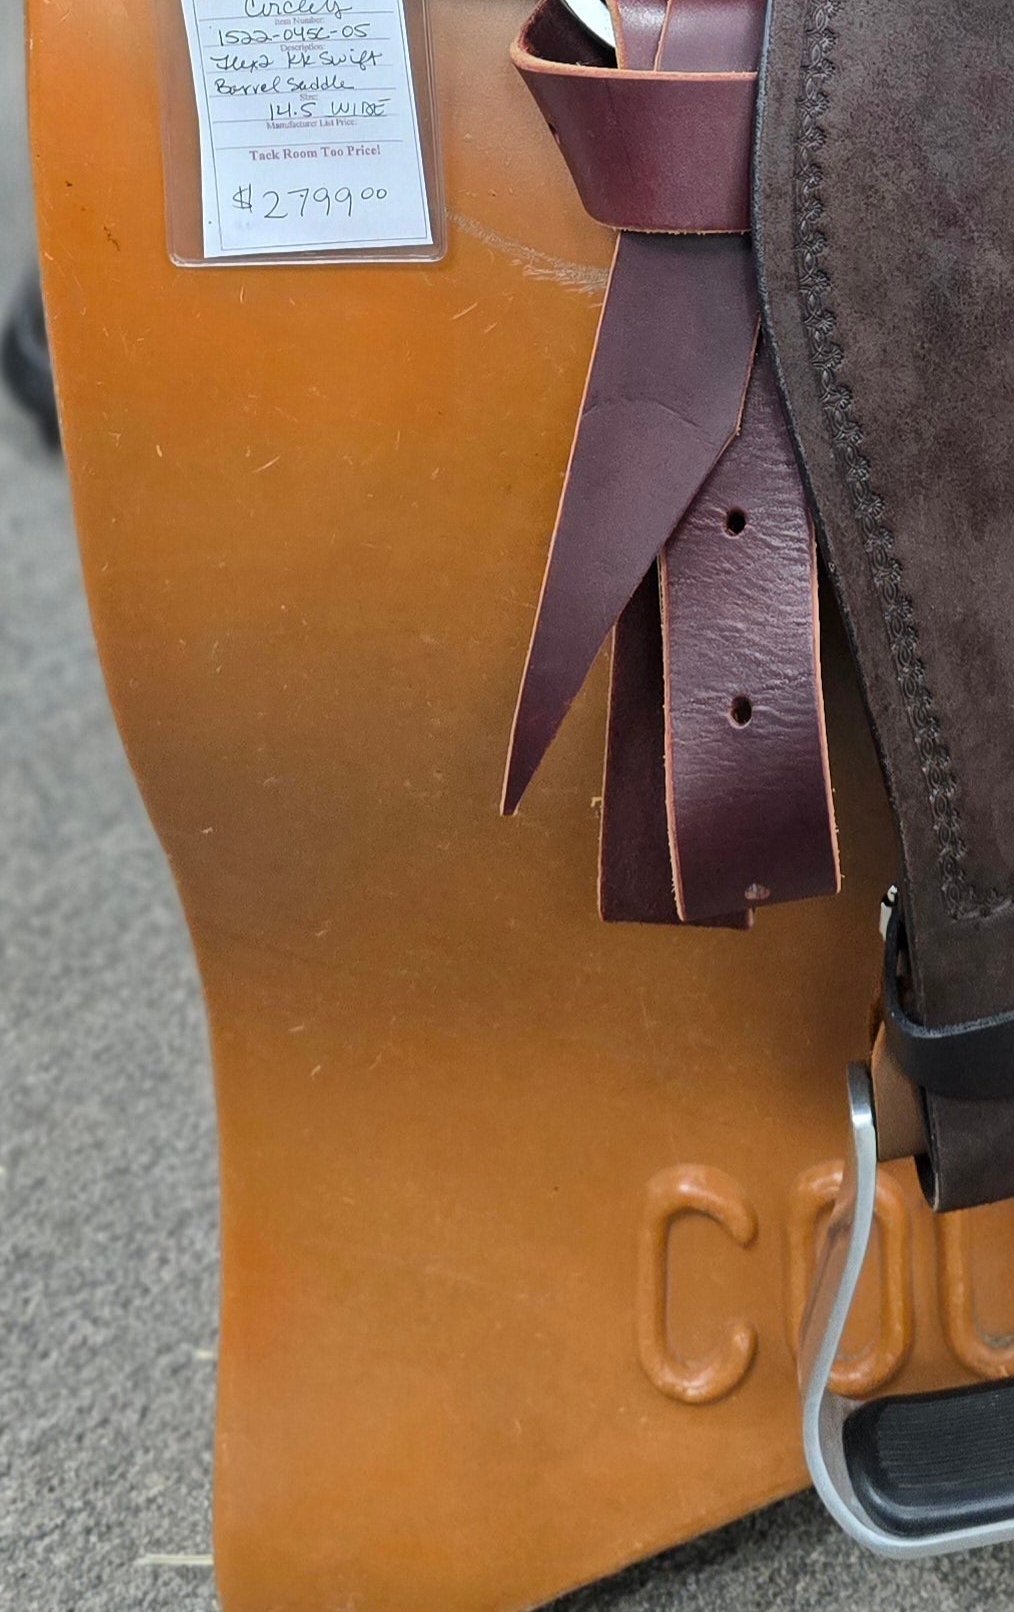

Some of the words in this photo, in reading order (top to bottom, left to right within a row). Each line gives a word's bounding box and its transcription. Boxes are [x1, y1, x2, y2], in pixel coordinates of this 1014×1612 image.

[214, 75, 281, 95] Barrel
[269, 101, 316, 121] 14.5
[266, 120, 318, 130] Manufacturer
[249, 149, 280, 161] Tack
[283, 147, 318, 160] Room
[320, 146, 344, 158] Too
[347, 144, 381, 156] Price!
